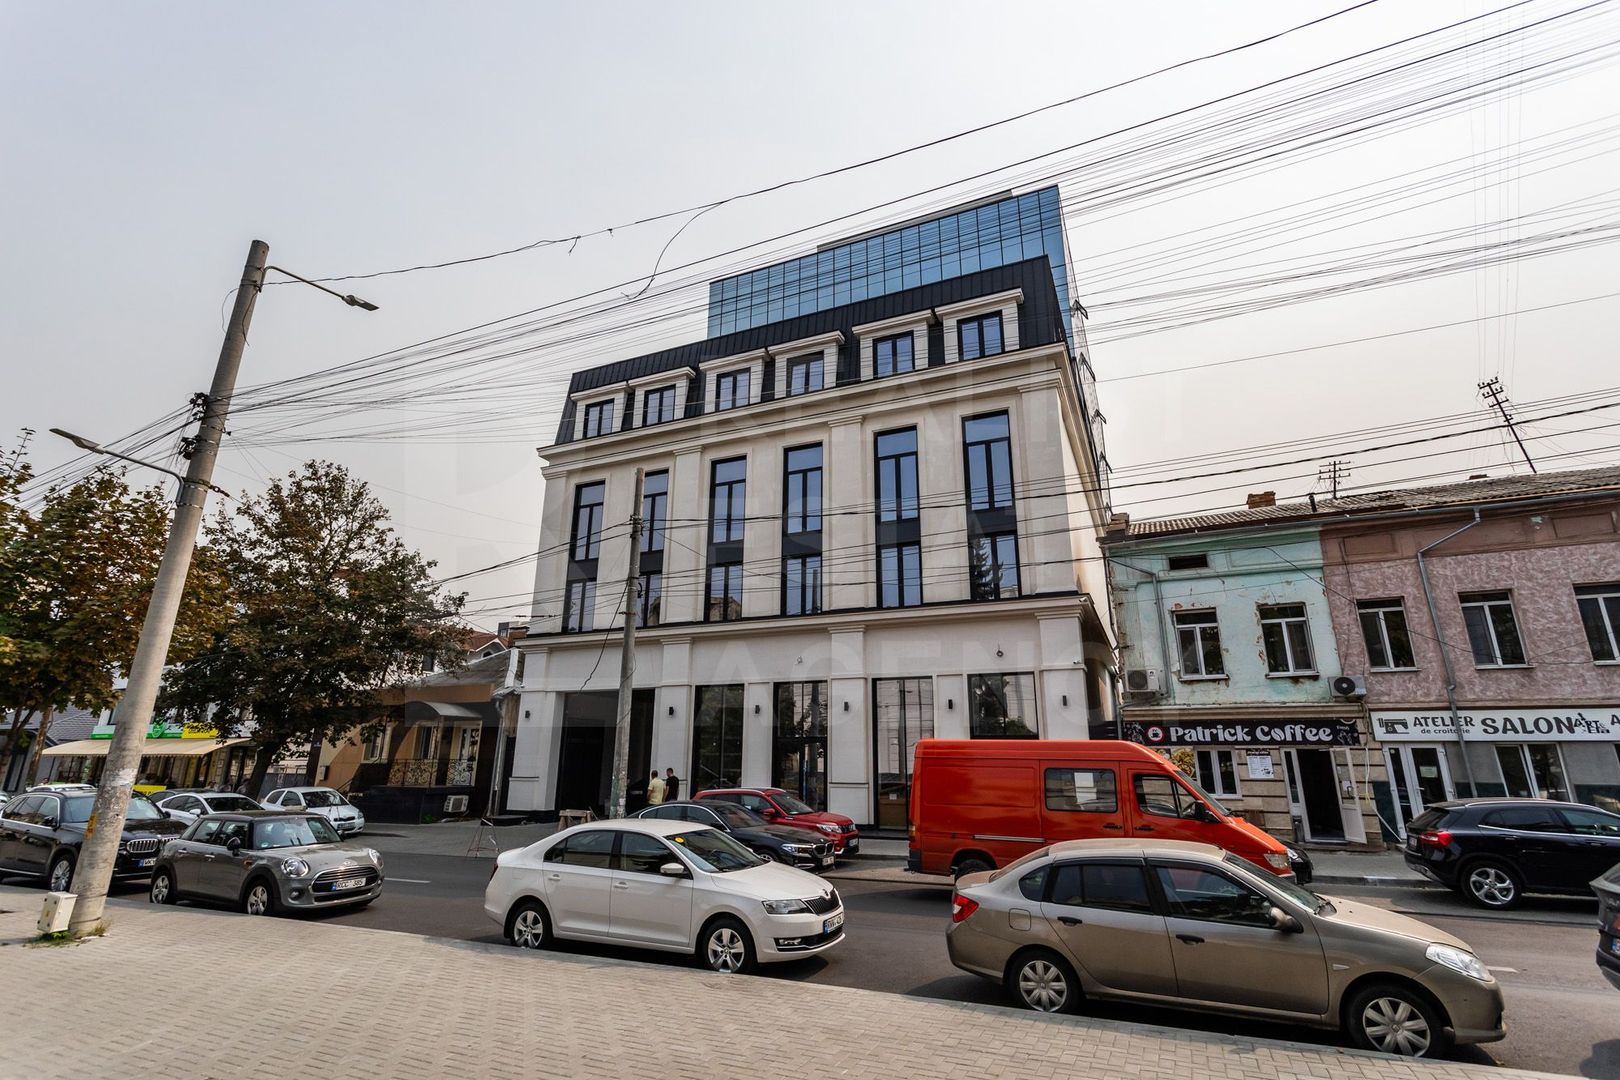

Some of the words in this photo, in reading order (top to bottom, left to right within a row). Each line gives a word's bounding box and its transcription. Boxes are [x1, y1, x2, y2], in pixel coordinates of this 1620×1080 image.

[1169, 724, 1251, 743] Patrick
[1255, 724, 1334, 743] Coffee
[1420, 727, 1431, 735] de
[1480, 716, 1576, 735] SALON
